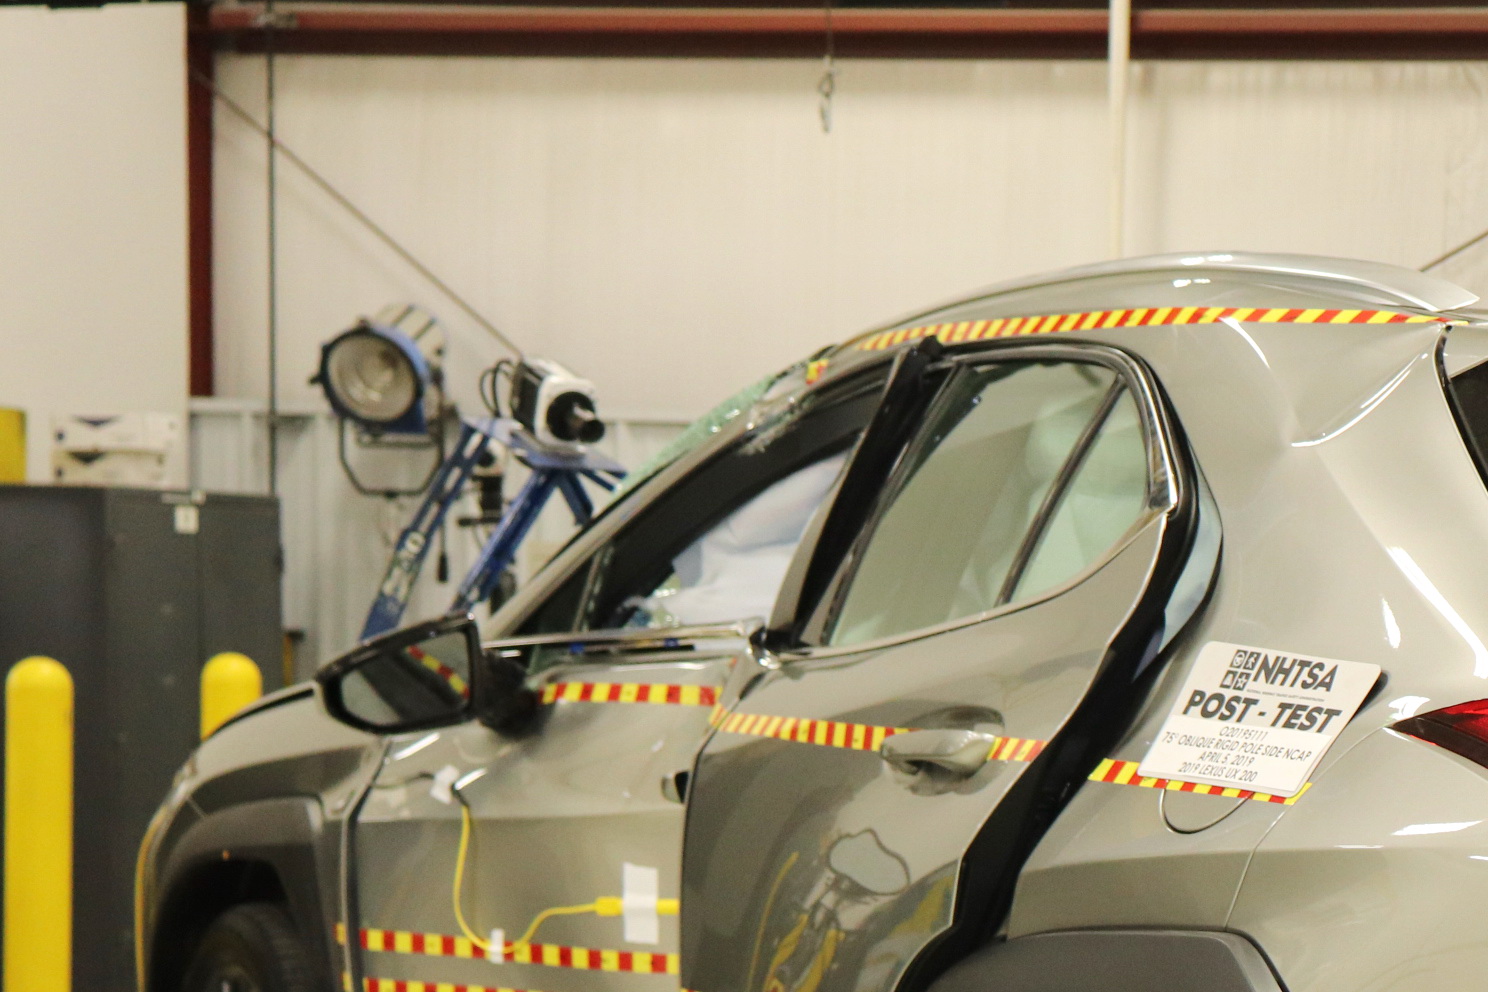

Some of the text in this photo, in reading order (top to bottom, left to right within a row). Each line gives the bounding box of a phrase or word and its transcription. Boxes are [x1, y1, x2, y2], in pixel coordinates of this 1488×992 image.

[1252, 653, 1339, 692] NHTSA
[1182, 689, 1260, 723] POST
[1270, 702, 1343, 734] TEST
[1178, 734, 1215, 749] OBLIQUE
[1214, 738, 1239, 751] RIGID
[1239, 742, 1265, 755] POLE
[1264, 745, 1284, 758] SIDE
[1283, 748, 1312, 762] NCAP
[1199, 751, 1221, 763] APRIL
[1231, 755, 1256, 767] 2019
[1178, 762, 1258, 782] 2019 LEXUS UX 200
